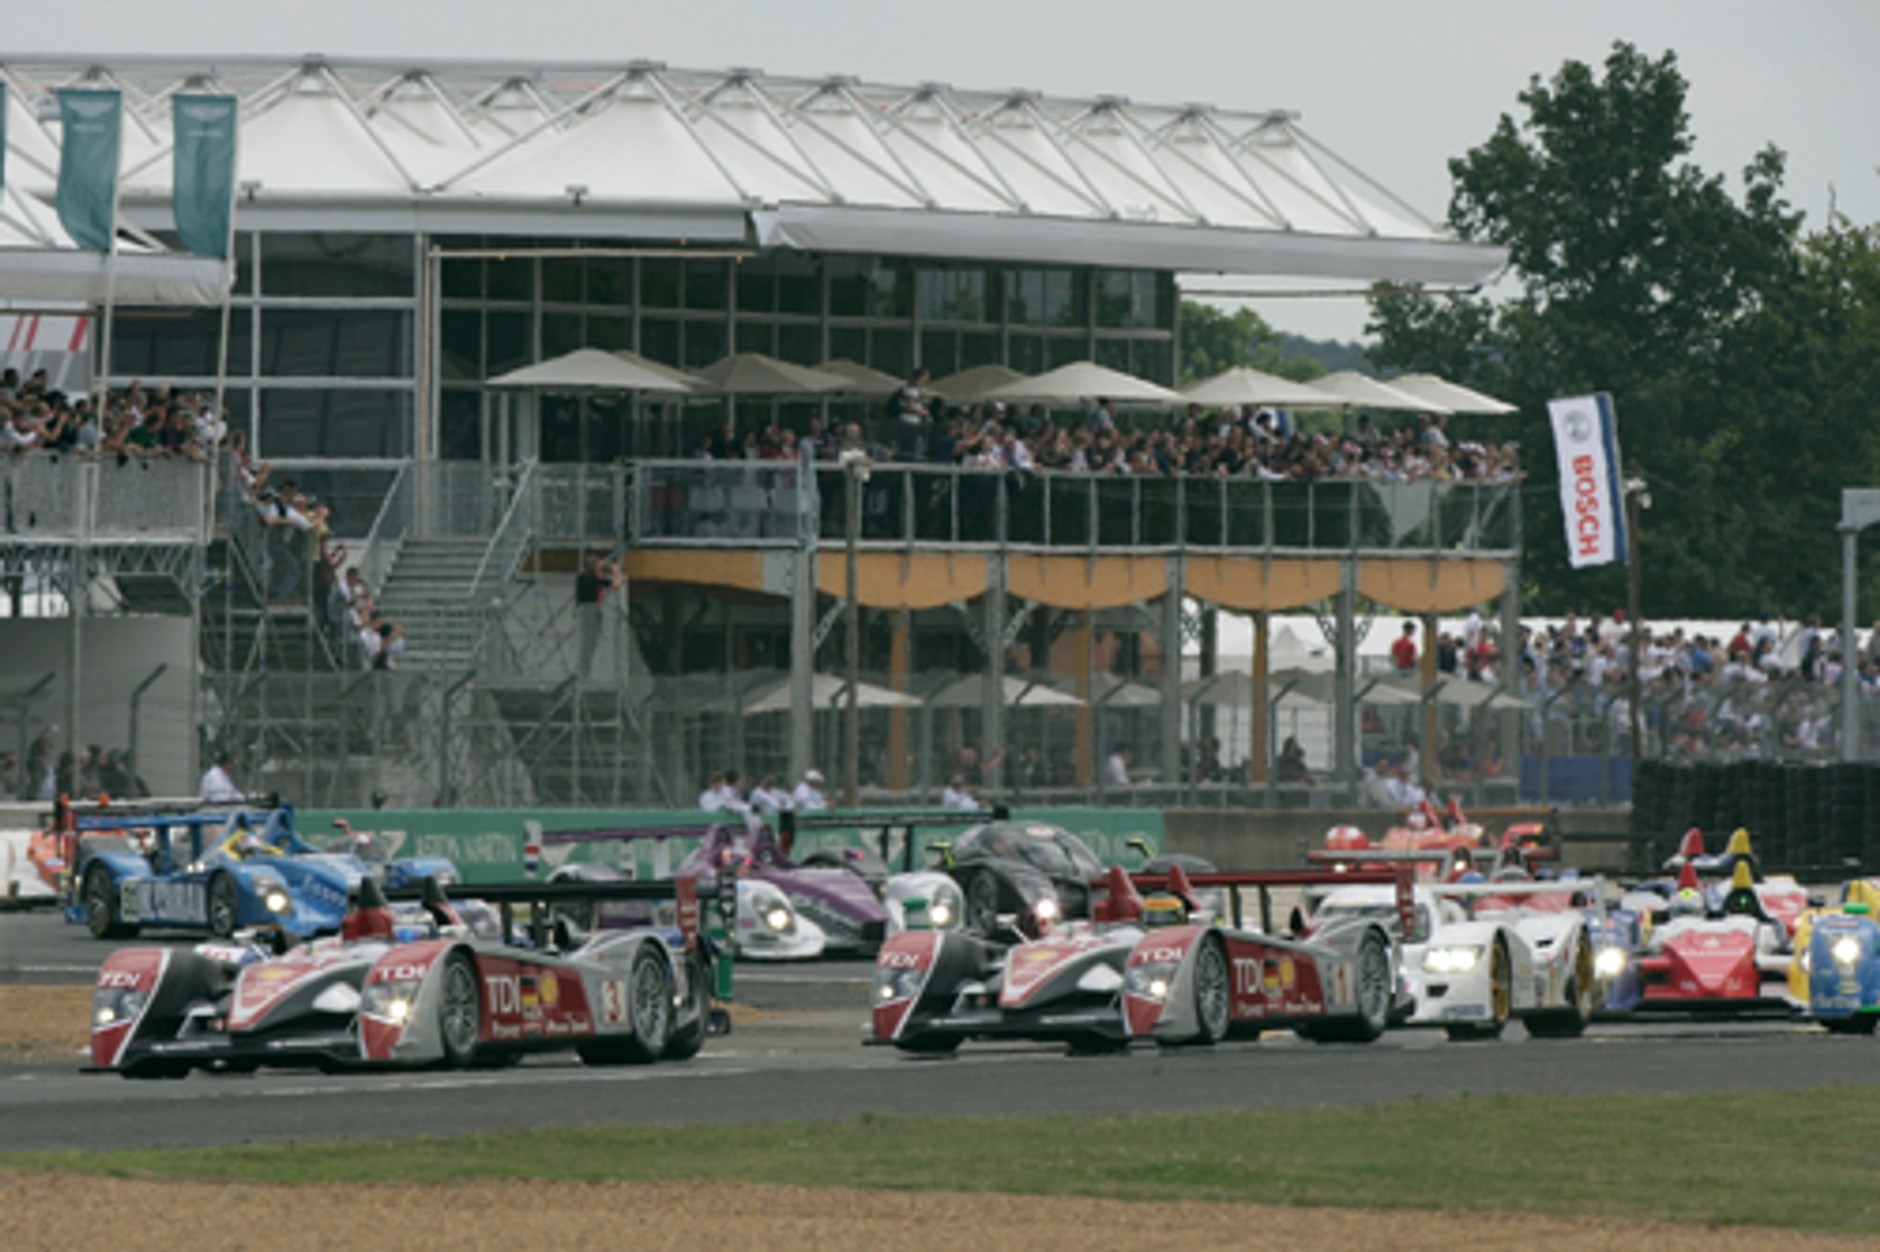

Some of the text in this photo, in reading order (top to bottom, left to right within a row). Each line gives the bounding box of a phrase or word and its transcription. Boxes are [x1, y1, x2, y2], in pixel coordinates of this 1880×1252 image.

[1572, 455, 1600, 556] BOSCH
[376, 966, 428, 981] TDI
[1138, 947, 1184, 962] TDI
[485, 975, 521, 1014] TDI
[1233, 957, 1264, 995] TDI
[606, 980, 622, 1023] 3
